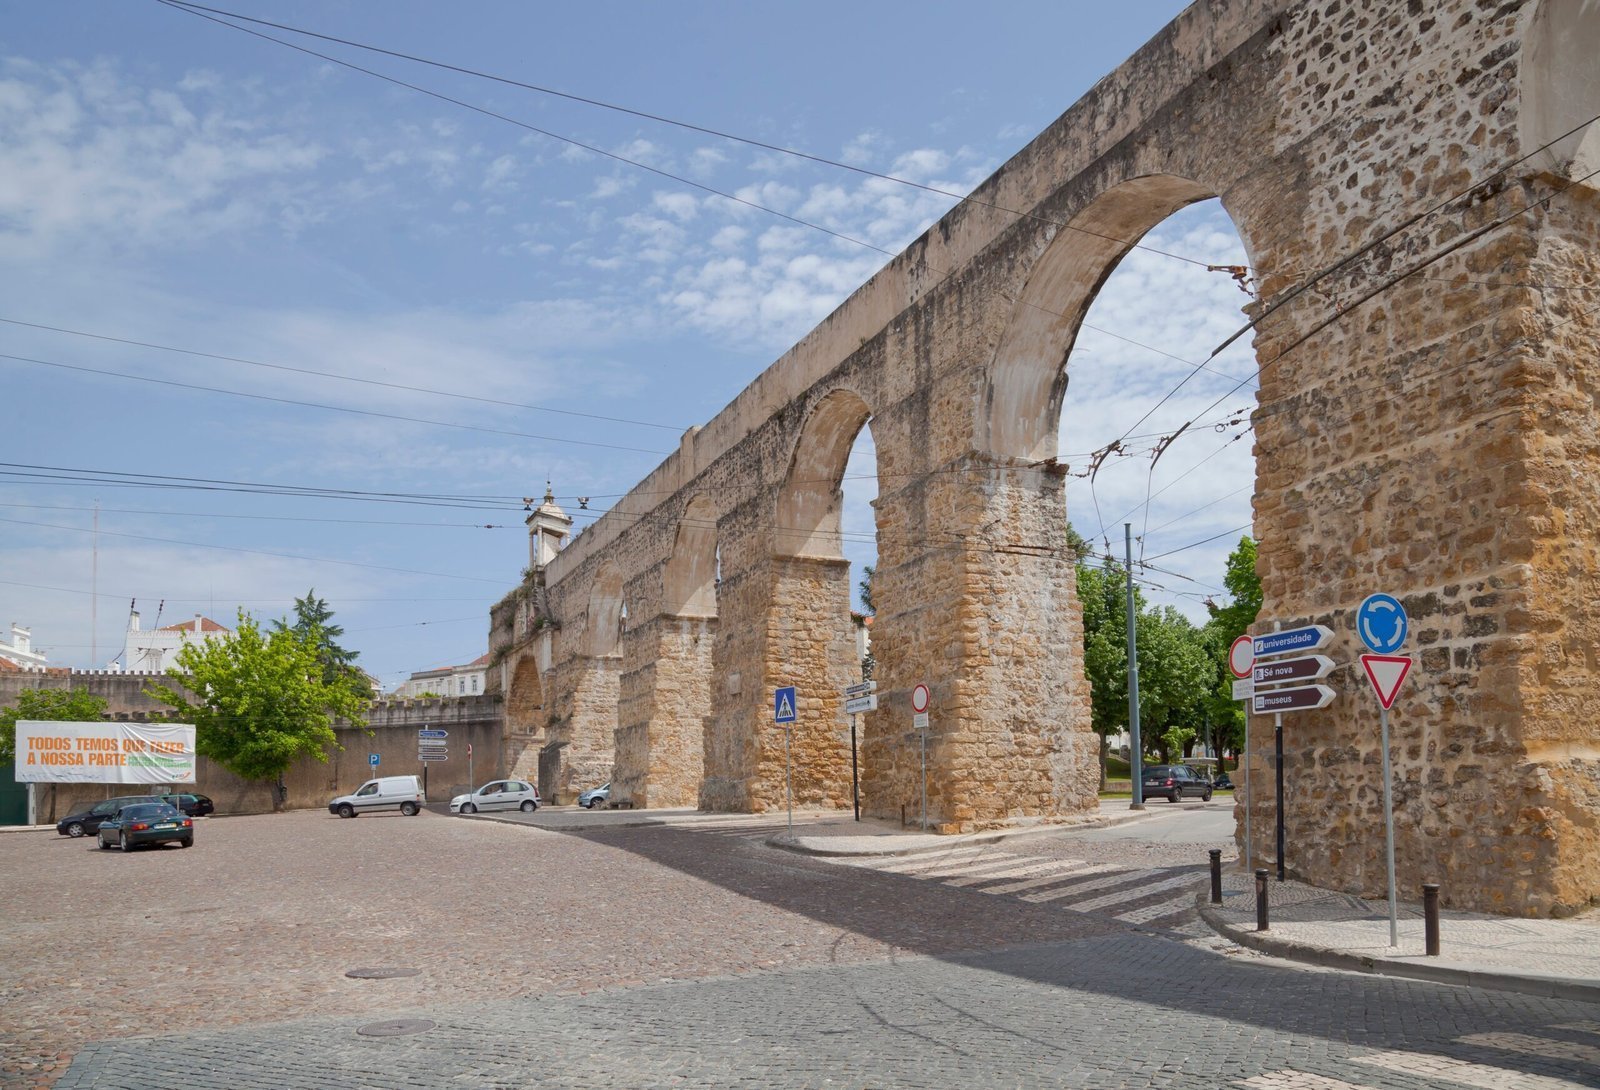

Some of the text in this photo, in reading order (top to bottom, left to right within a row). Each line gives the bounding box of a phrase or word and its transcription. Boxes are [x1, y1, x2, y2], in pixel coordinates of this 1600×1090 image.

[1263, 633, 1312, 648] universidade
[1264, 666, 1293, 677] Sé nova
[1264, 695, 1292, 705] museus
[27, 737, 71, 751] TODOS
[75, 738, 118, 751] TEMOS
[123, 739, 146, 753] QUE
[27, 753, 35, 765] A
[40, 753, 84, 766] NOSSA
[88, 753, 127, 766] PARTE
[371, 755, 378, 764] P
